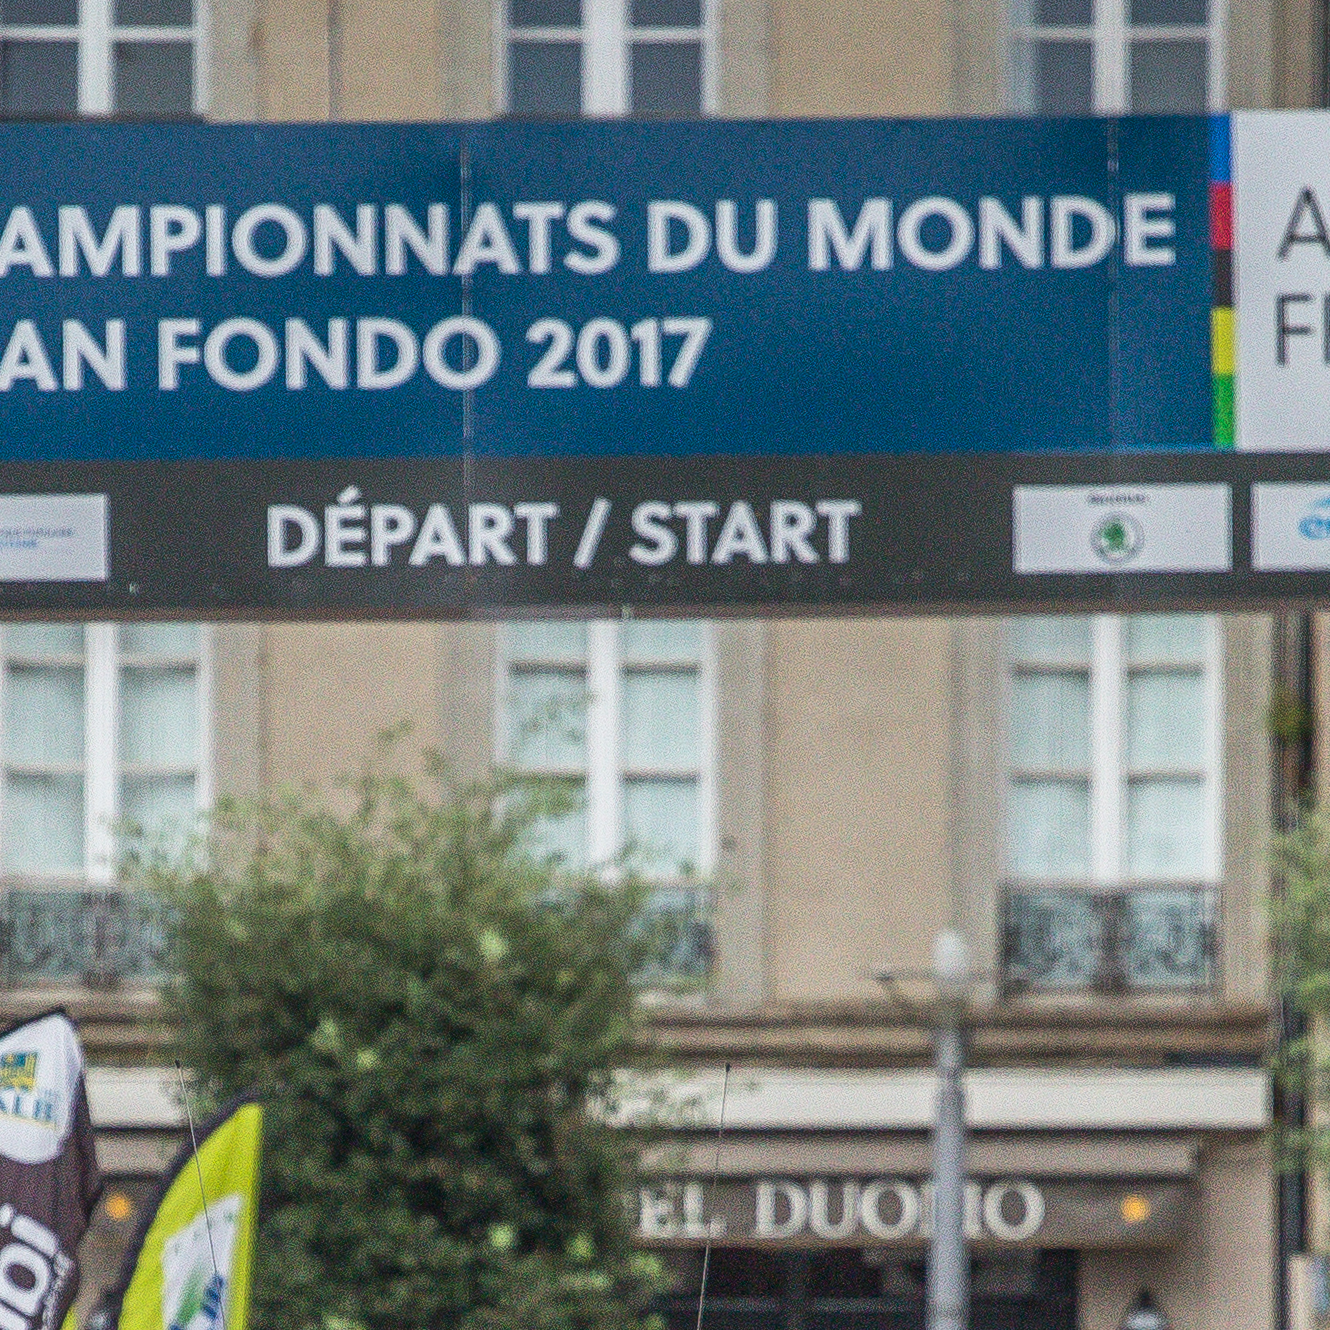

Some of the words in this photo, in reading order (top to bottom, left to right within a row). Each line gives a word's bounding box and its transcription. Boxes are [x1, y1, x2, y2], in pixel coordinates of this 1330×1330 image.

[648, 198, 776, 272] DU
[808, 194, 1176, 271] MONDE
[158, 316, 502, 391] FONDO
[527, 317, 712, 388] 2017
[267, 485, 557, 568] DÉPART
[573, 498, 609, 569] /
[630, 500, 861, 566] START
[639, 1183, 726, 1241] EL
